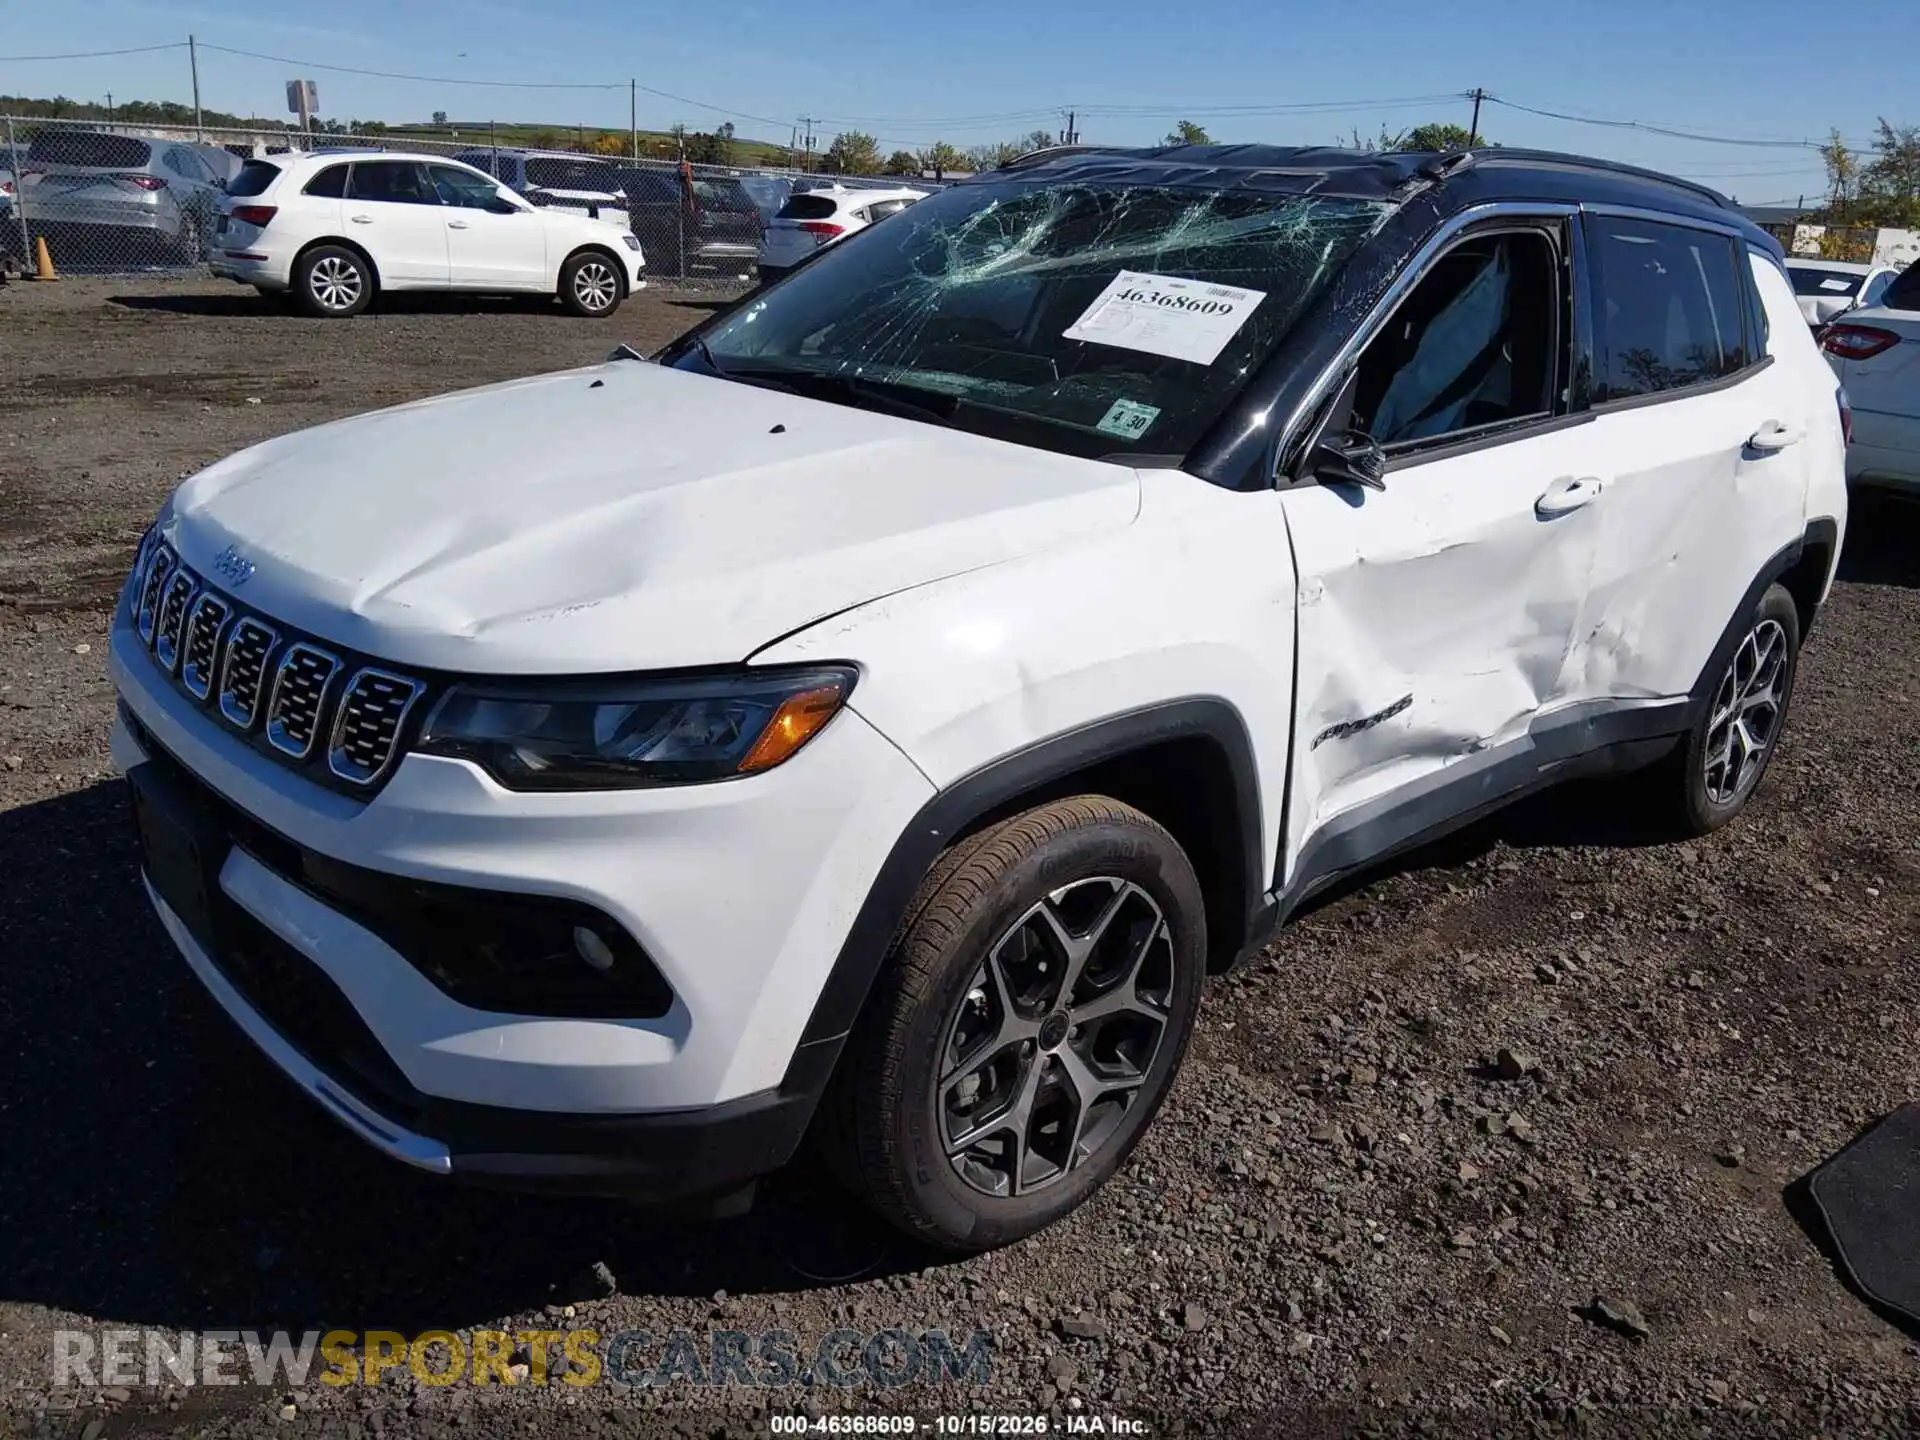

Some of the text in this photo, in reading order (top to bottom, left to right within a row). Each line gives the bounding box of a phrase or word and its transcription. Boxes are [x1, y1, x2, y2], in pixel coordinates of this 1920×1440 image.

[1116, 288, 1233, 317] 46368609
[1112, 410, 1124, 423] 4
[1127, 415, 1146, 430] 30
